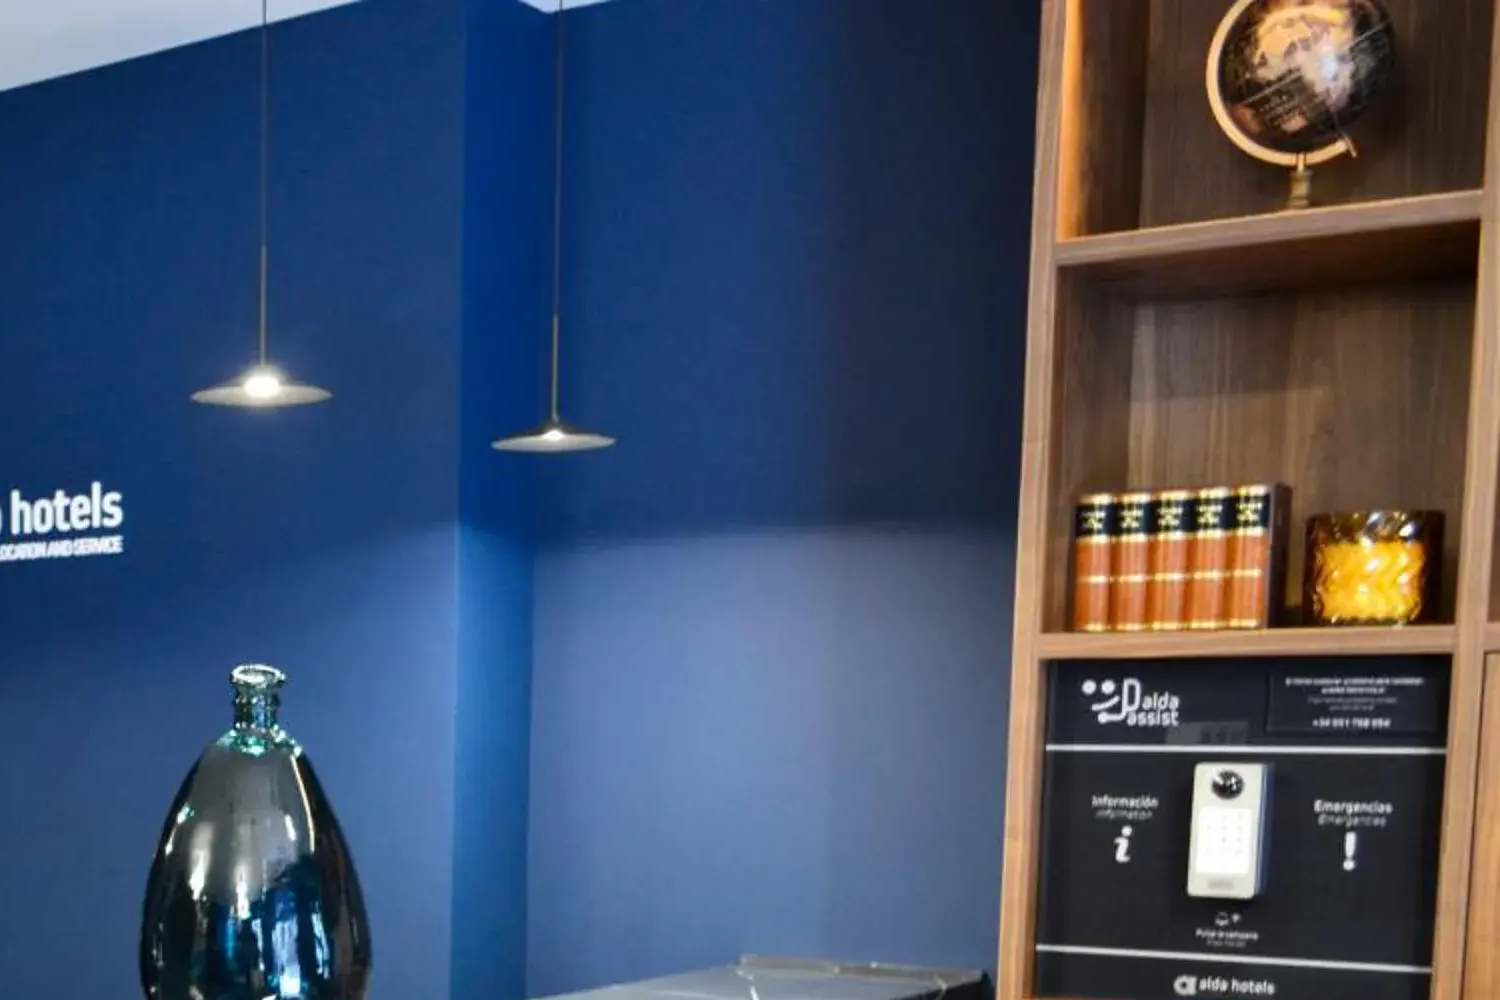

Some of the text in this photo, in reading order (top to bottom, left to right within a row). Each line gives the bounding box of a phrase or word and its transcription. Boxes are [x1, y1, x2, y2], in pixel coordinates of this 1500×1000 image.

[10, 481, 124, 536] hotels
[47, 539, 72, 558] AND
[73, 535, 124, 556] SERVICE
[1142, 691, 1179, 710] alda
[1127, 710, 1179, 727] assist
[1092, 793, 1159, 809] Información
[1314, 799, 1393, 815] Emergencias
[1199, 976, 1228, 992] alda
[1231, 976, 1275, 996] hotels
